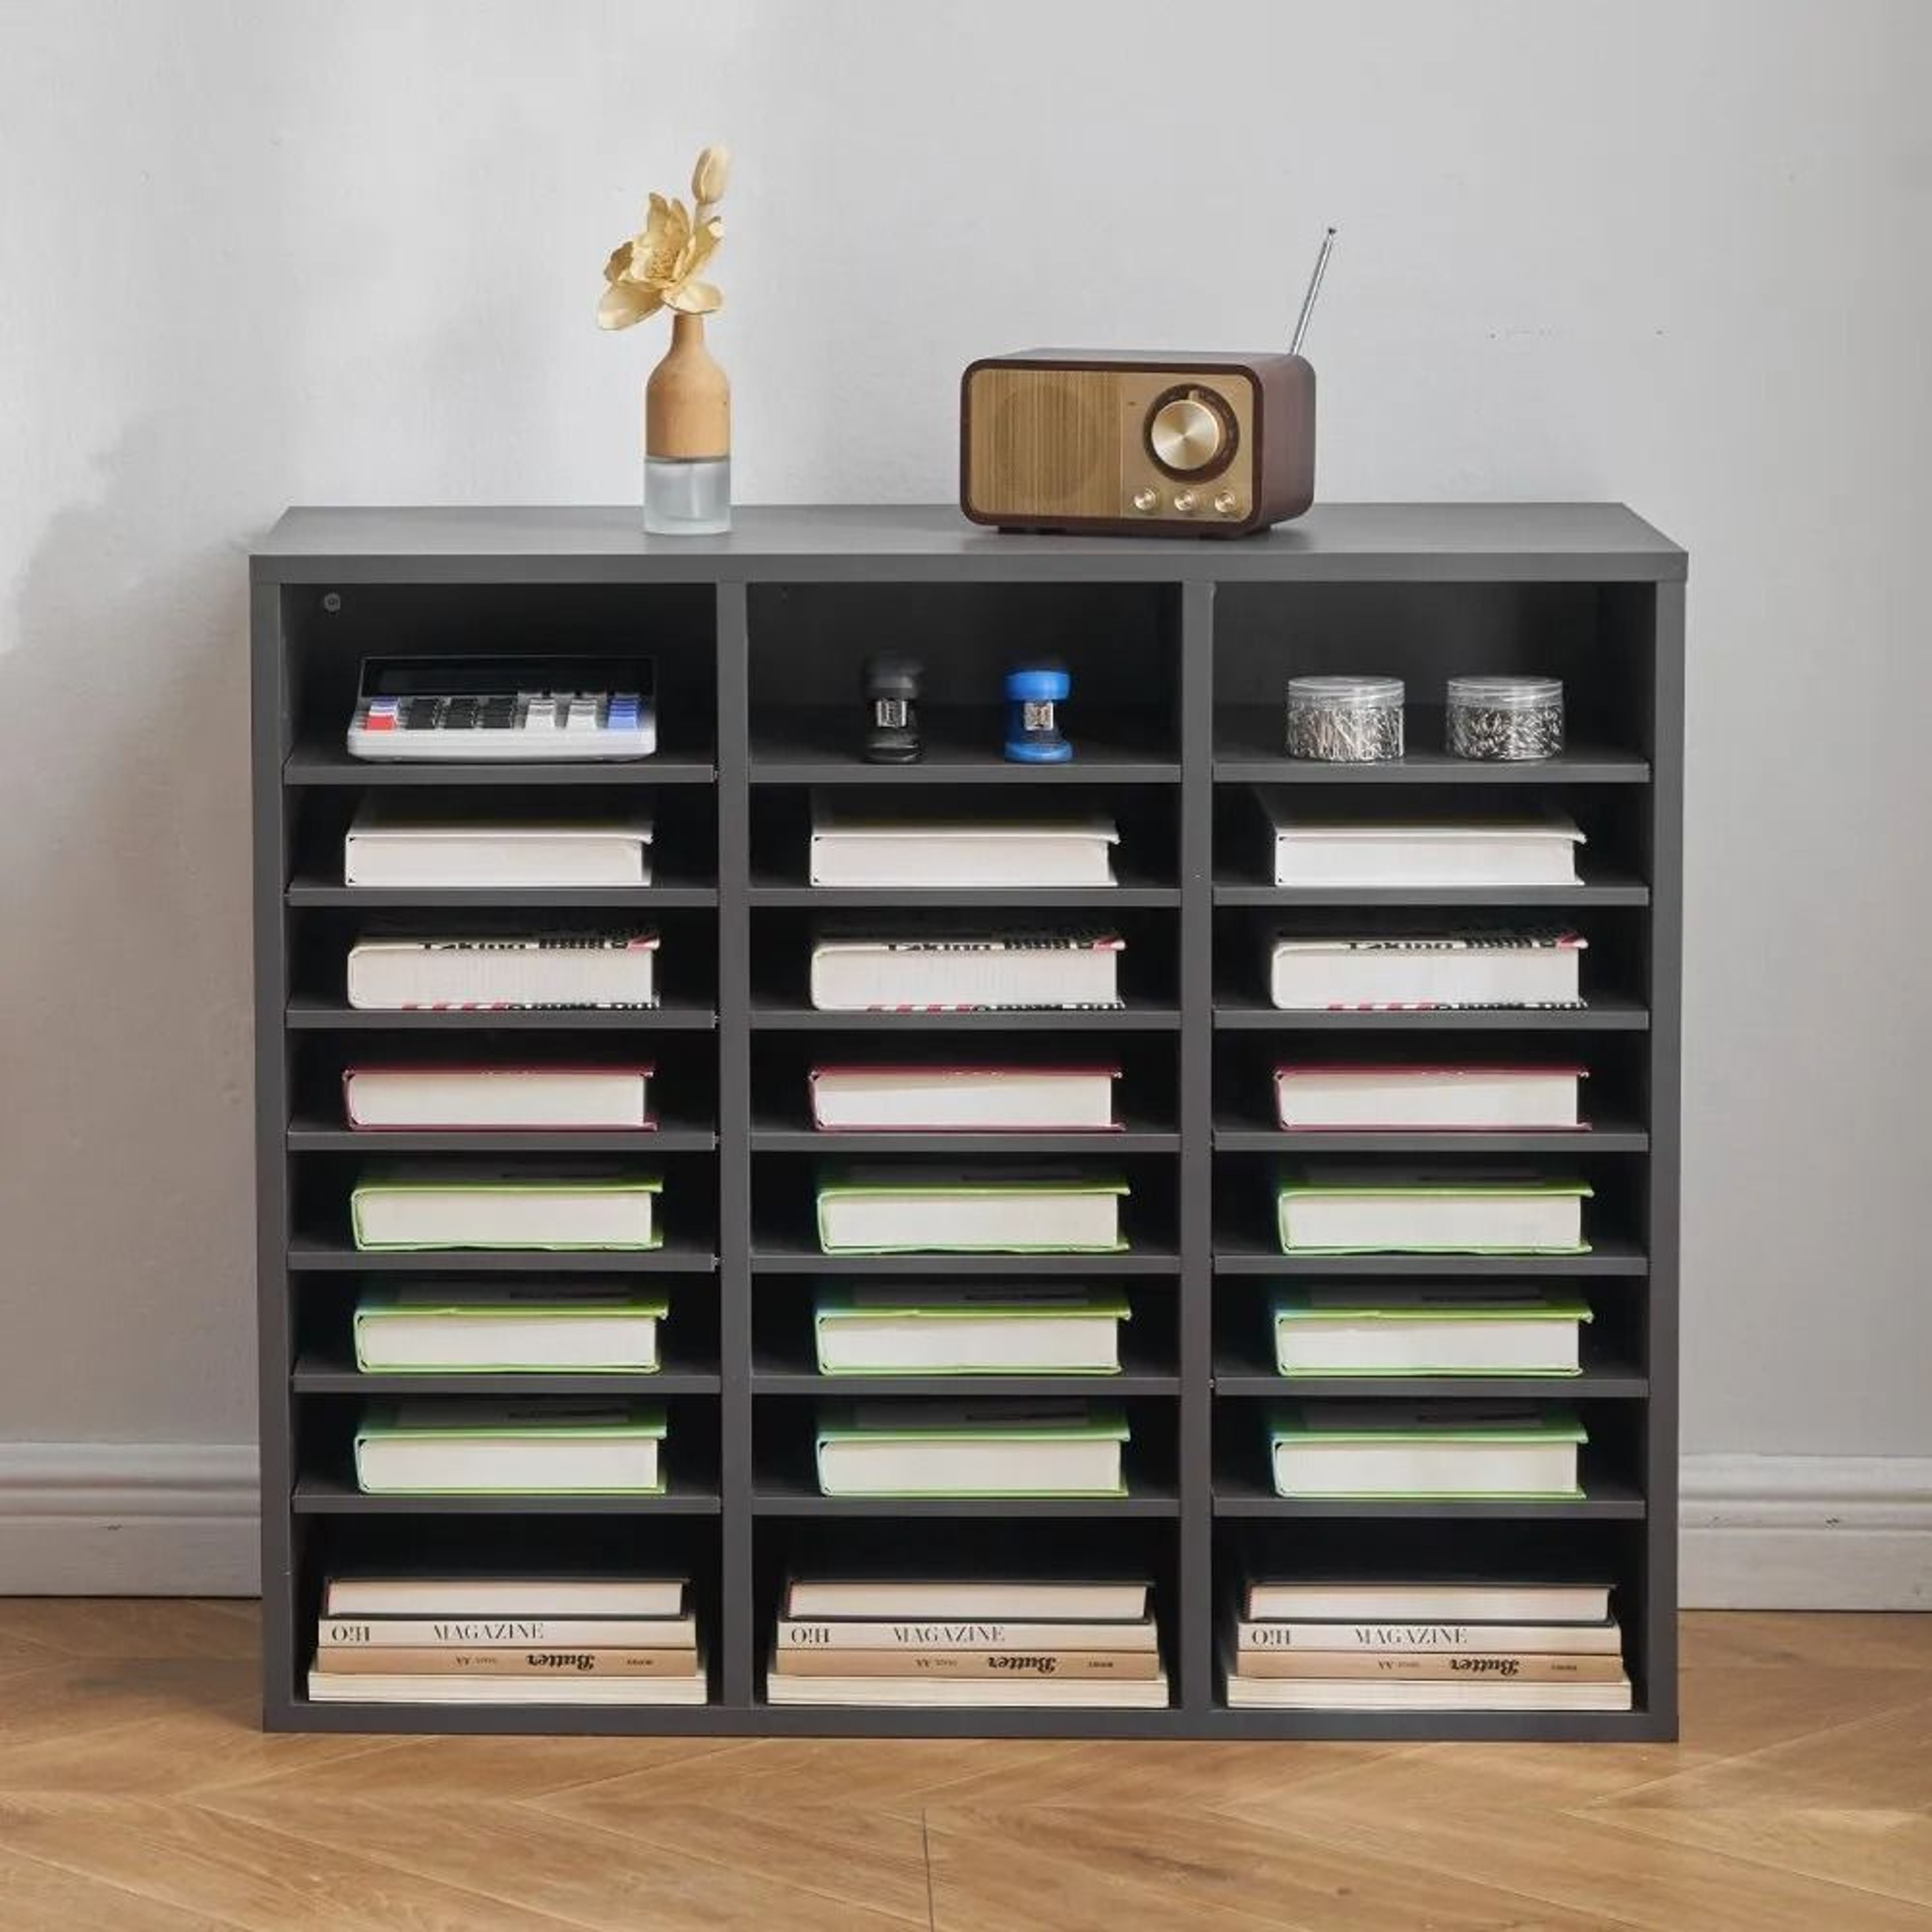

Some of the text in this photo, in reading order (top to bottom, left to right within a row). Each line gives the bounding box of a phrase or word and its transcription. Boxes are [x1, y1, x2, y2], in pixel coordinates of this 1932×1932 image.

[433, 1624, 544, 1640] MAGAZINE
[893, 1626, 1006, 1642] MAGAZINE
[1354, 1627, 1468, 1644] MAGAZINE
[527, 1654, 596, 1670] Butter
[988, 1656, 1057, 1673] Butter
[1450, 1659, 1520, 1676] Butter
